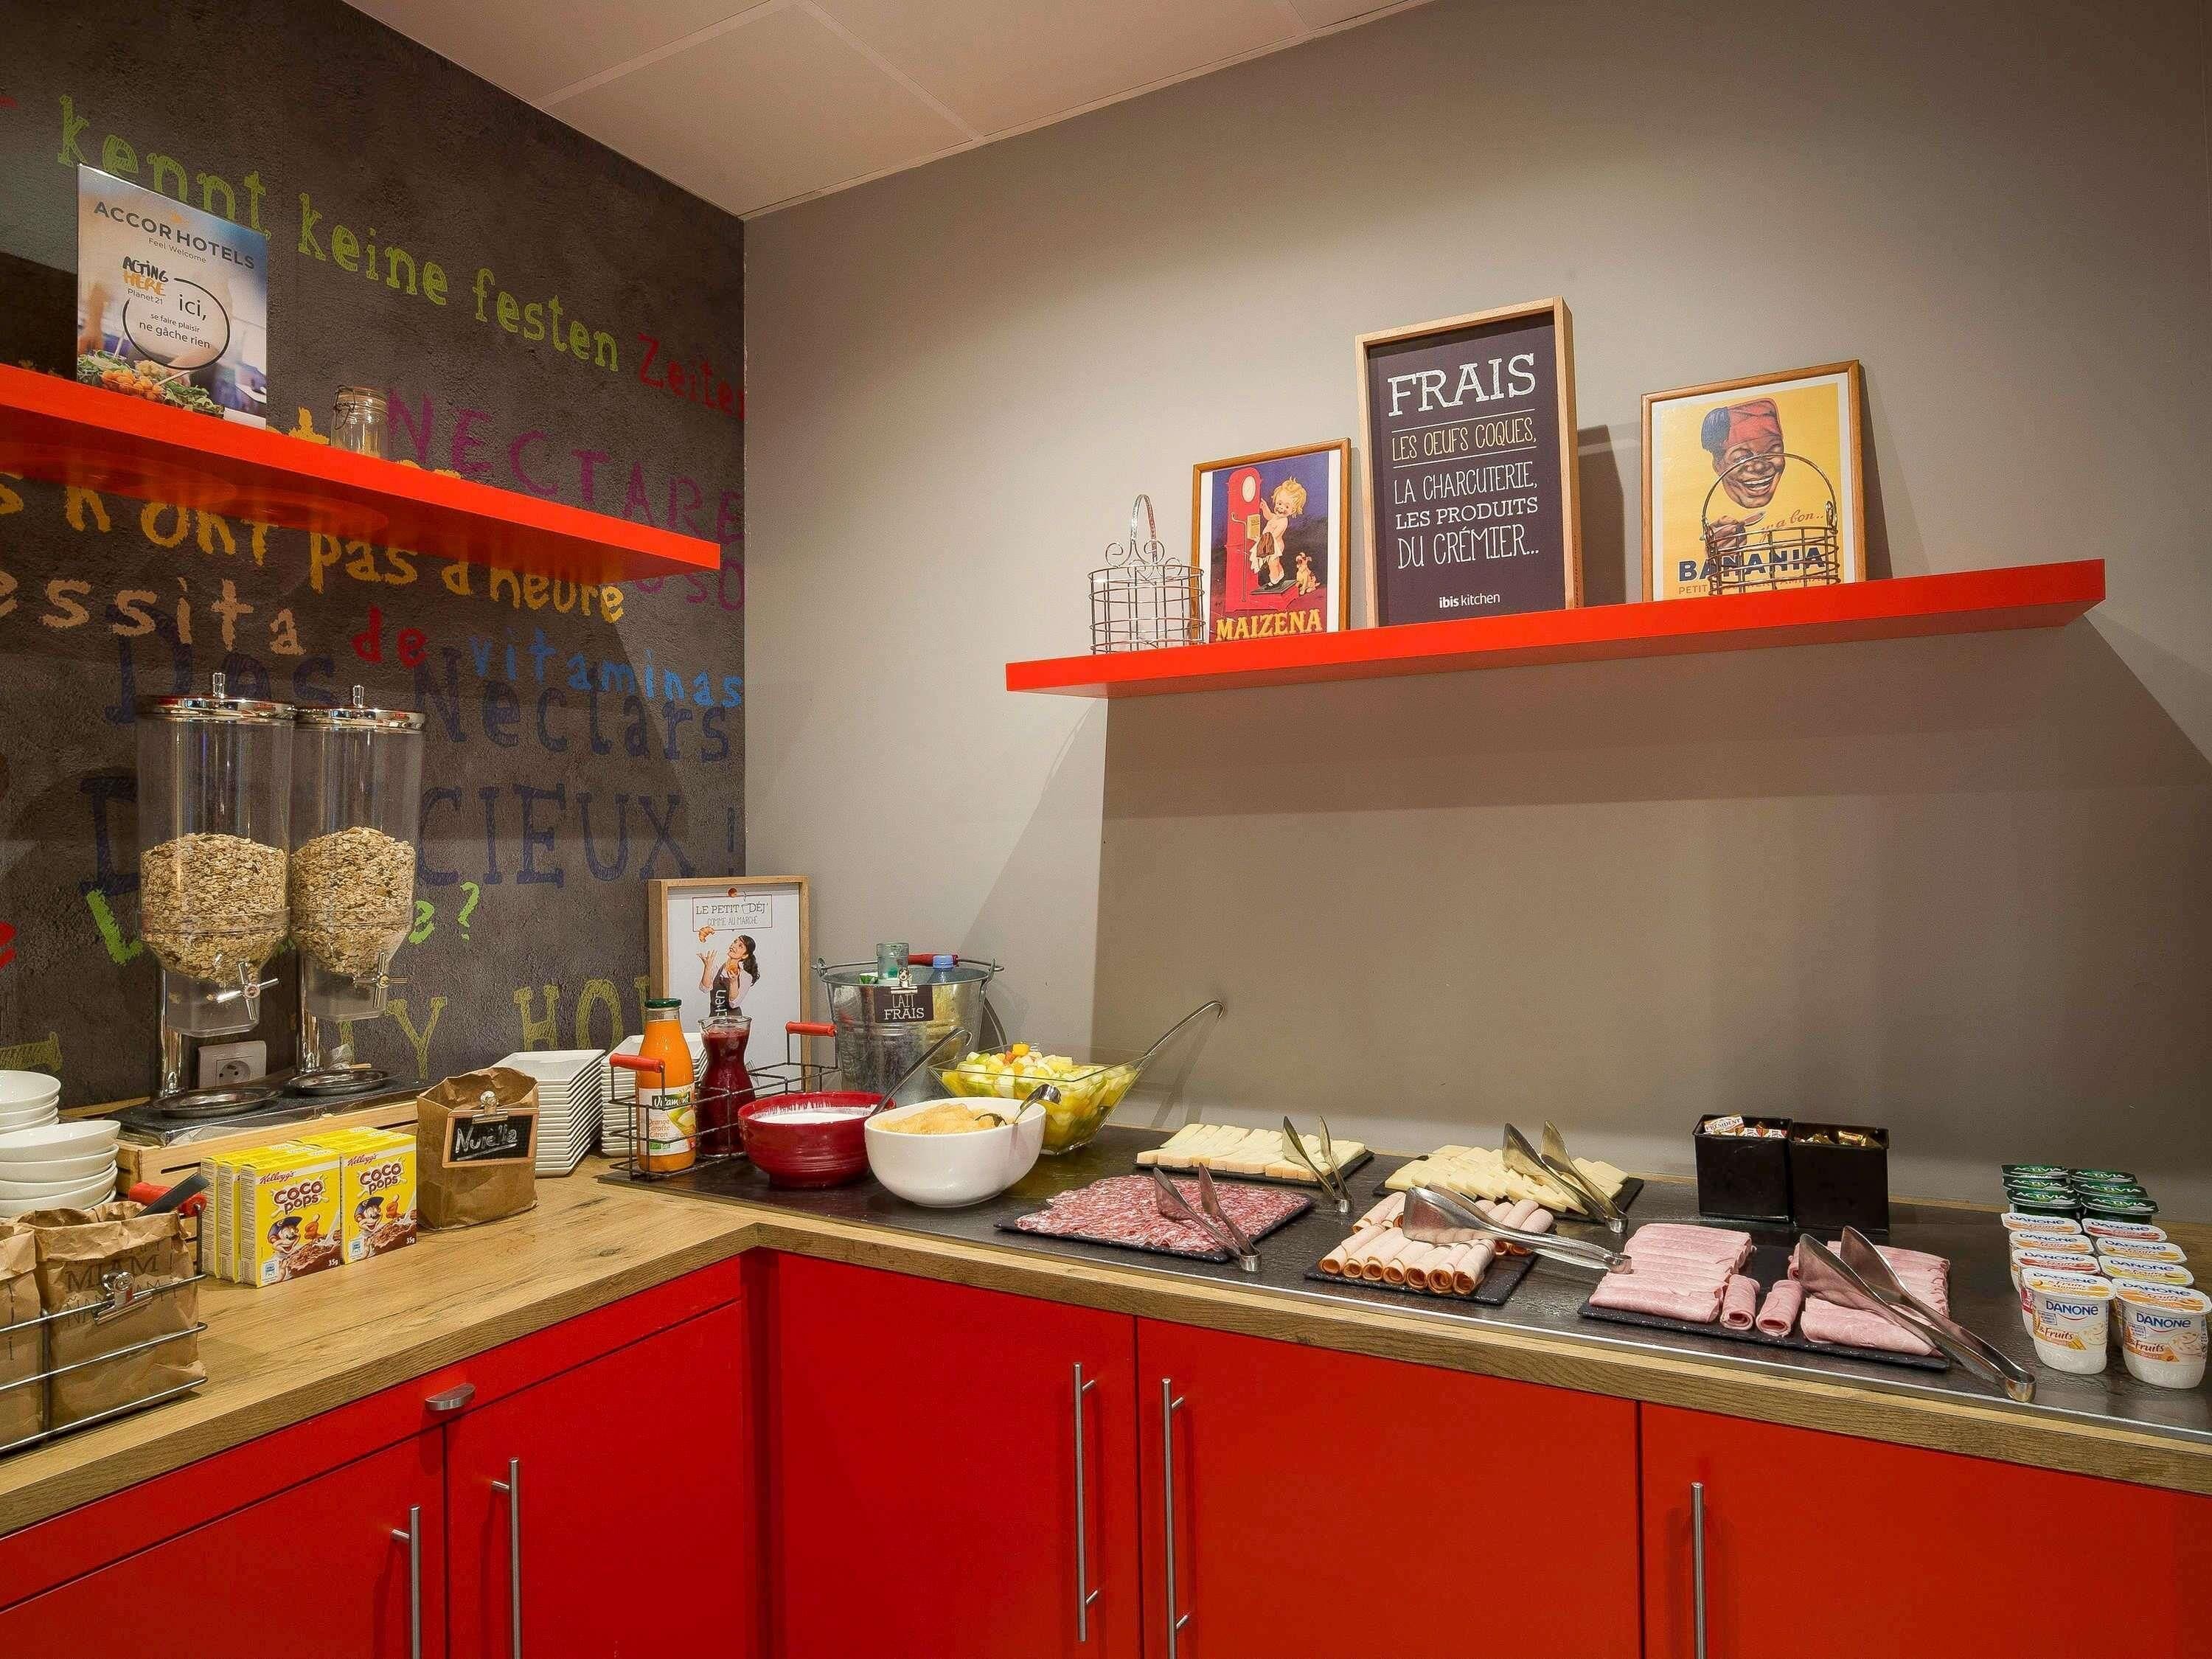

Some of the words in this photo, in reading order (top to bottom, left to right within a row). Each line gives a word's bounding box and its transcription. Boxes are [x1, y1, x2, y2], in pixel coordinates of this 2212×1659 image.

[57, 94, 271, 240] kennt
[297, 192, 448, 306] keine
[472, 268, 619, 371] festen
[148, 237, 167, 250] Feel
[168, 245, 207, 264] Welcome
[122, 271, 166, 296] HERE
[178, 293, 207, 321] ici,
[160, 314, 177, 326] faire
[178, 321, 201, 333] plaisir
[139, 321, 153, 332] ne
[156, 324, 188, 343] gâche
[189, 335, 211, 349] rien
[1387, 352, 1536, 417] FRAIS
[1391, 434, 1418, 462] LES
[1423, 425, 1469, 456] OEUFS
[1475, 417, 1537, 449] COQUES,
[1394, 476, 1416, 505] LA
[1423, 461, 1538, 500] CHARCUTERIE,
[1396, 511, 1430, 530] LES
[1436, 496, 1539, 526] PRODUITS
[1397, 534, 1425, 570] DU
[1433, 524, 1540, 568] CRÉMIER...
[309, 529, 419, 594] pas
[1678, 546, 1825, 582] BANANIA
[1439, 594, 1459, 609] ibis
[1460, 591, 1500, 607] kitchen
[1678, 584, 1708, 595] PETIT
[1215, 608, 1323, 641] MAIZENA
[350, 603, 429, 668] de
[469, 627, 743, 708] vitaminas
[412, 646, 731, 762] Nectars
[695, 905, 709, 914] LE
[712, 904, 740, 914] PETIT
[891, 994, 914, 1009] LAIT
[883, 1007, 925, 1020] FRAIS
[347, 1153, 378, 1166] Kellogg's
[260, 1170, 295, 1185] Kellogg's
[369, 1175, 399, 1195] pops
[2080, 1183, 2141, 1193] ACTIVIA
[284, 1194, 319, 1215] pops
[2016, 1192, 2068, 1200] ACTIVIA
[2093, 1197, 2146, 1207] ACTIVIA
[328, 1259, 339, 1267] 35g
[2045, 1300, 2098, 1316] DANONE
[2136, 1312, 2191, 1328] DANONE
